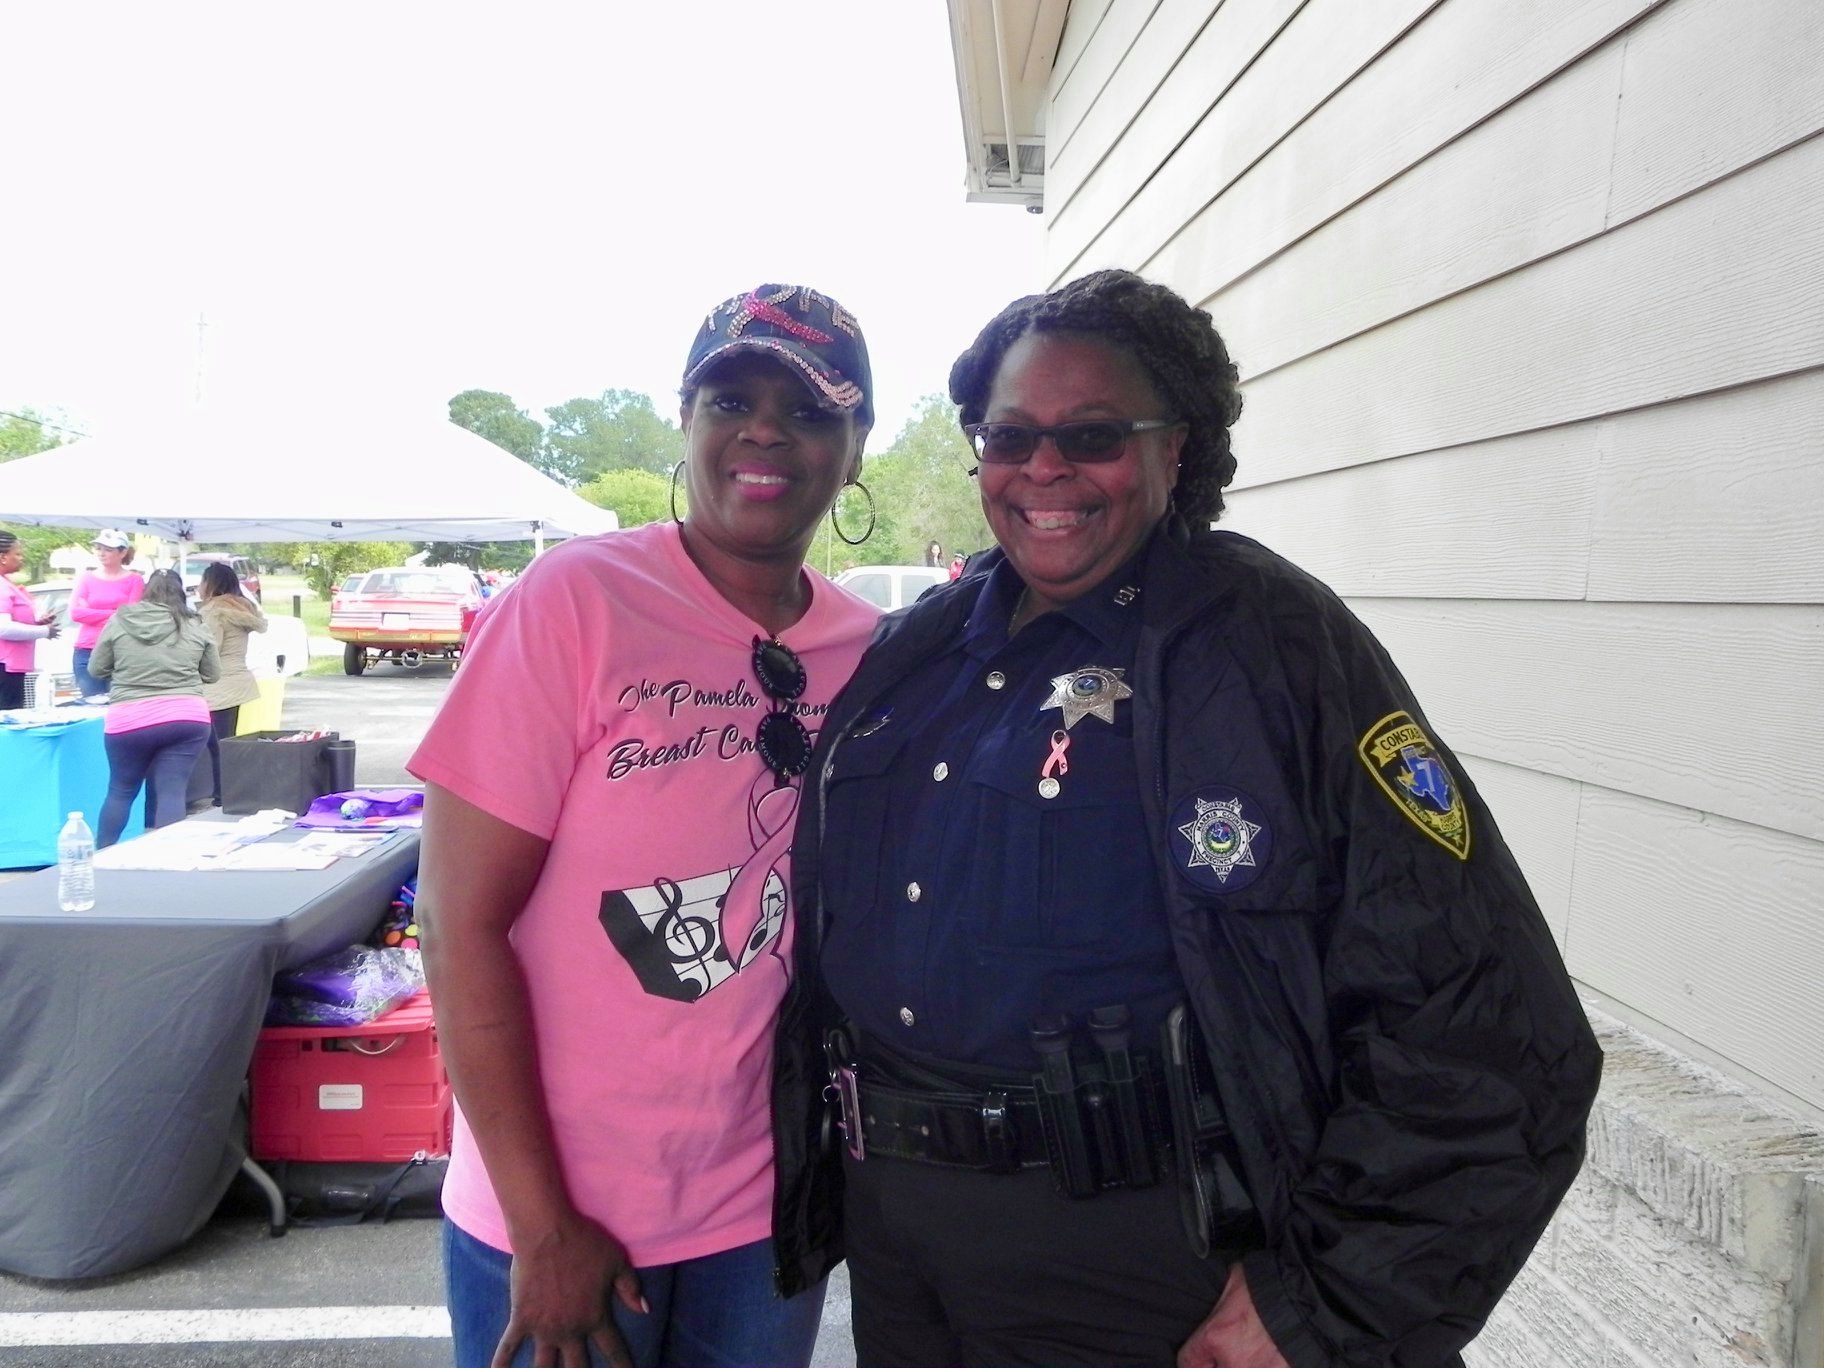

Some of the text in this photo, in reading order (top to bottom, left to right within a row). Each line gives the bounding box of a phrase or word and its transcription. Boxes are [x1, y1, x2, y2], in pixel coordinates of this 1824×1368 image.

[618, 678, 657, 712] The
[656, 678, 759, 718] Pamela
[607, 722, 759, 780] Breast Ca
[1416, 761, 1436, 793] 7
[1222, 811, 1244, 831] COUNTY
